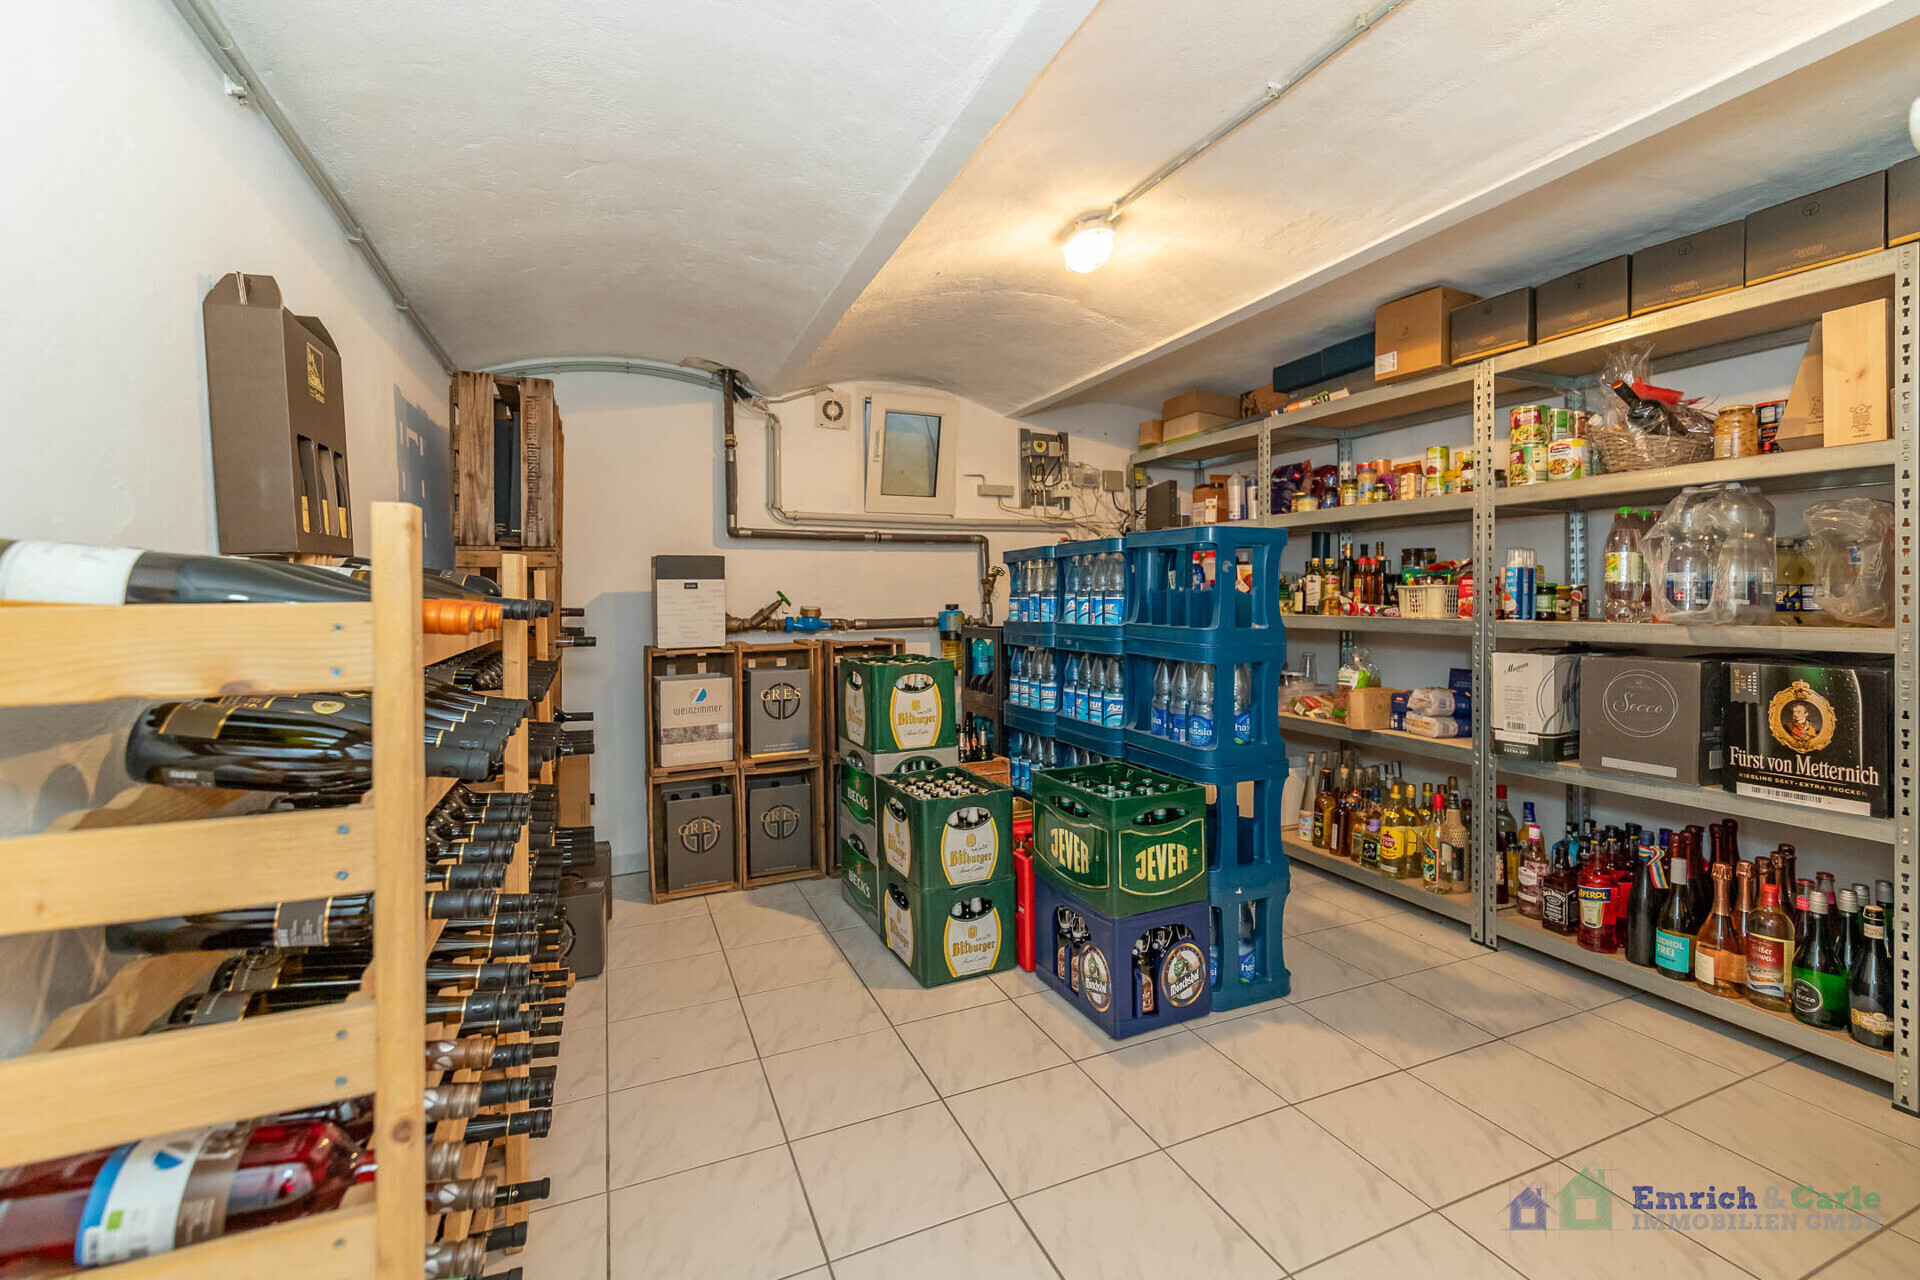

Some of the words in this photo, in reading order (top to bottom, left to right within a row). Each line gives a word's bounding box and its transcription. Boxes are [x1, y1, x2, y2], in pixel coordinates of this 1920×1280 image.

[760, 687, 802, 701] GRES
[673, 704, 723, 716] weinzimmer
[1729, 745, 1765, 770] Fürst
[1766, 756, 1793, 773] von
[1795, 754, 1880, 787] Metternich
[1774, 777, 1794, 785] SEKT
[1798, 781, 1826, 791] EXTRA
[678, 819, 722, 837] GRES
[949, 848, 993, 867] Bitburger
[1050, 828, 1090, 874] JEVER
[1135, 843, 1189, 882] JEVER
[1578, 888, 1607, 900] APEROL
[952, 940, 996, 957] Bitburger
